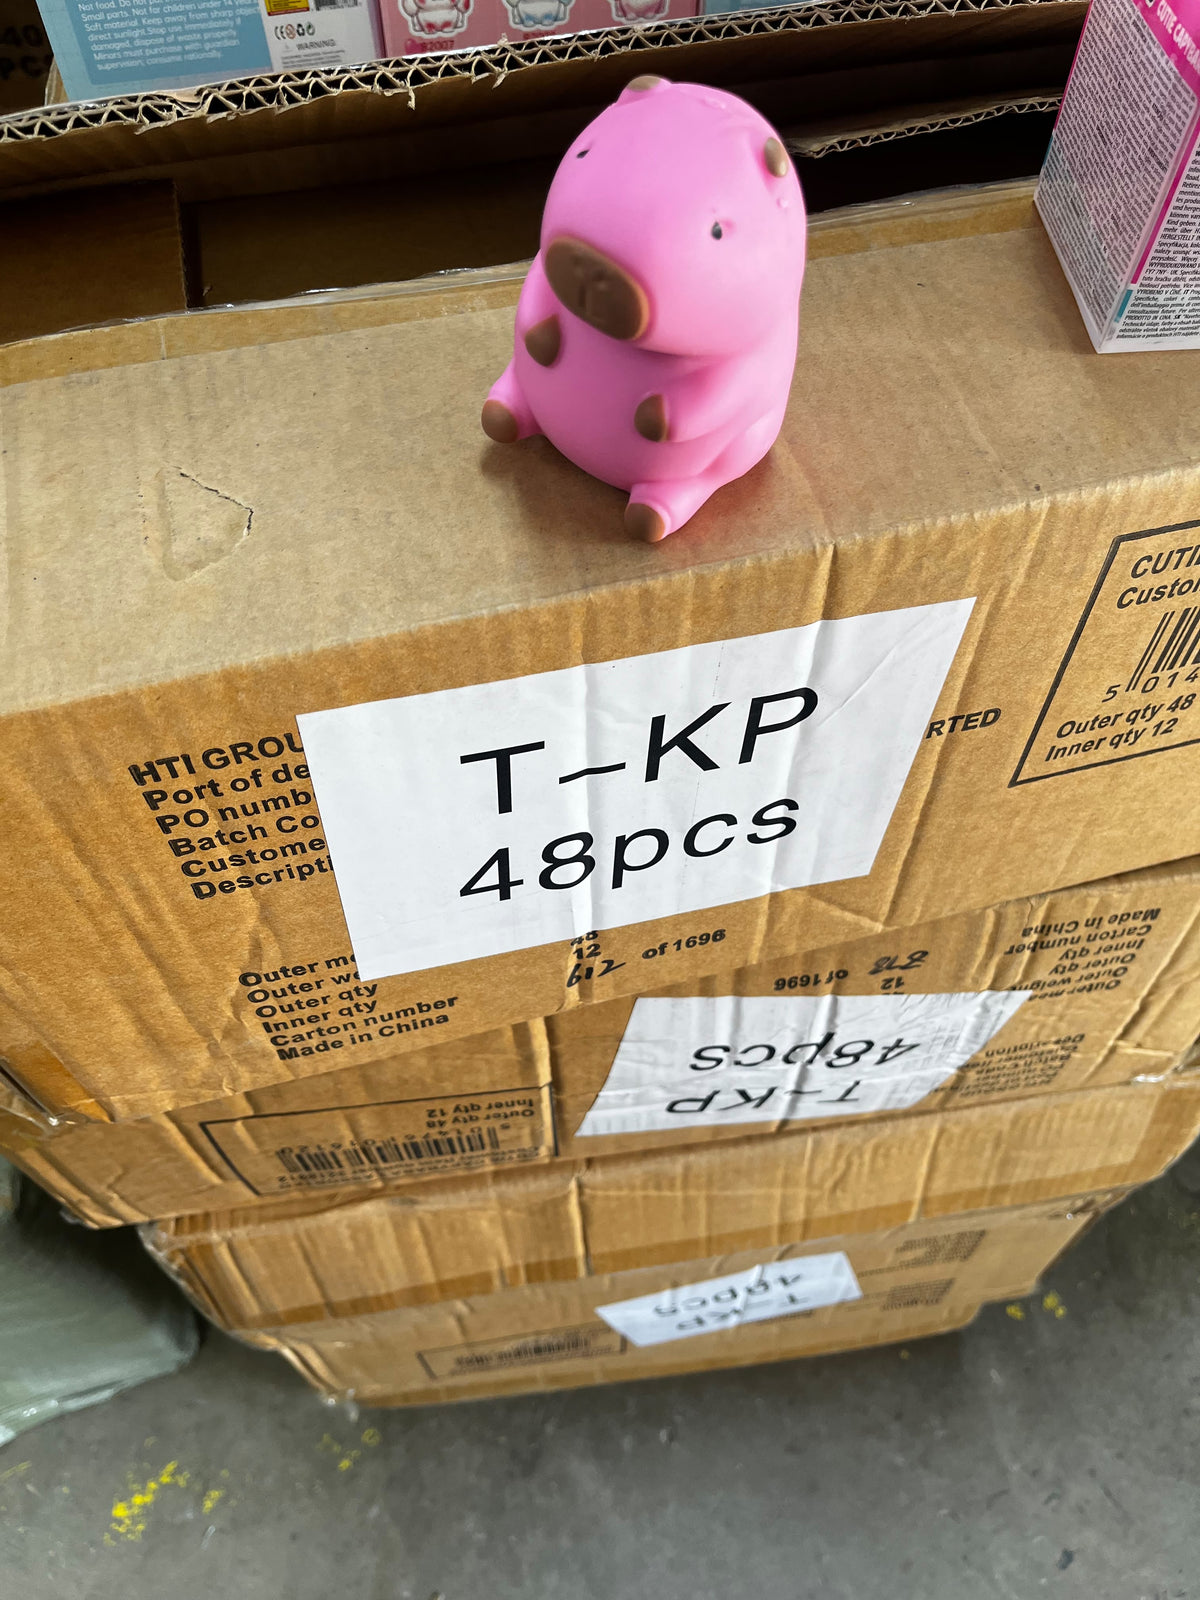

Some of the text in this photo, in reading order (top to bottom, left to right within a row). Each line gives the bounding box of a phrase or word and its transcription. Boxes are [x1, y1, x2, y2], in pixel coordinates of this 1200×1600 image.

[78, 3, 94, 11] Not
[81, 12, 105, 21] Small
[132, 8, 147, 16] Not
[149, 6, 160, 14] for
[162, 3, 196, 13] children
[197, 0, 219, 9] under
[84, 22, 101, 32] Soft
[142, 16, 163, 25] Keep
[164, 15, 187, 23] away
[188, 12, 208, 20] from
[210, 10, 234, 18] sharp
[1157, 0, 1178, 34] CUTIE
[88, 33, 112, 41] direct
[1102, 684, 1121, 702] 5
[926, 707, 1002, 739] RTED
[1056, 693, 1197, 739] Outer qty 48
[1045, 717, 1179, 763] Inner qty 12
[128, 753, 197, 787] HTI
[142, 763, 311, 811] Port of de
[155, 788, 317, 835] PO numb
[167, 815, 320, 858] Batch Co
[459, 798, 800, 902] 48pcs
[181, 838, 326, 878] Custome
[1021, 907, 1161, 938] Made in China
[573, 943, 602, 960] 12
[641, 928, 727, 960] of 1696
[1003, 924, 1152, 956] Carton number
[1058, 938, 1145, 963] Inner qty
[238, 961, 319, 987] Outer
[566, 959, 627, 988] 612
[774, 969, 849, 991] of 1696
[1048, 953, 1136, 976] Outer qty
[1076, 966, 1128, 986] Outer
[247, 979, 325, 1004] Outer
[880, 976, 905, 991] 12
[1070, 979, 1121, 996] Outer
[255, 983, 378, 1018] Outer qty
[262, 1000, 377, 1034] Inner qty
[270, 996, 459, 1047] Carton number
[276, 1013, 450, 1061] Made in China
[689, 1032, 922, 1072] 48pcs
[425, 1098, 535, 1119] Inner qty 12
[425, 1107, 535, 1130] Outer qty 48
